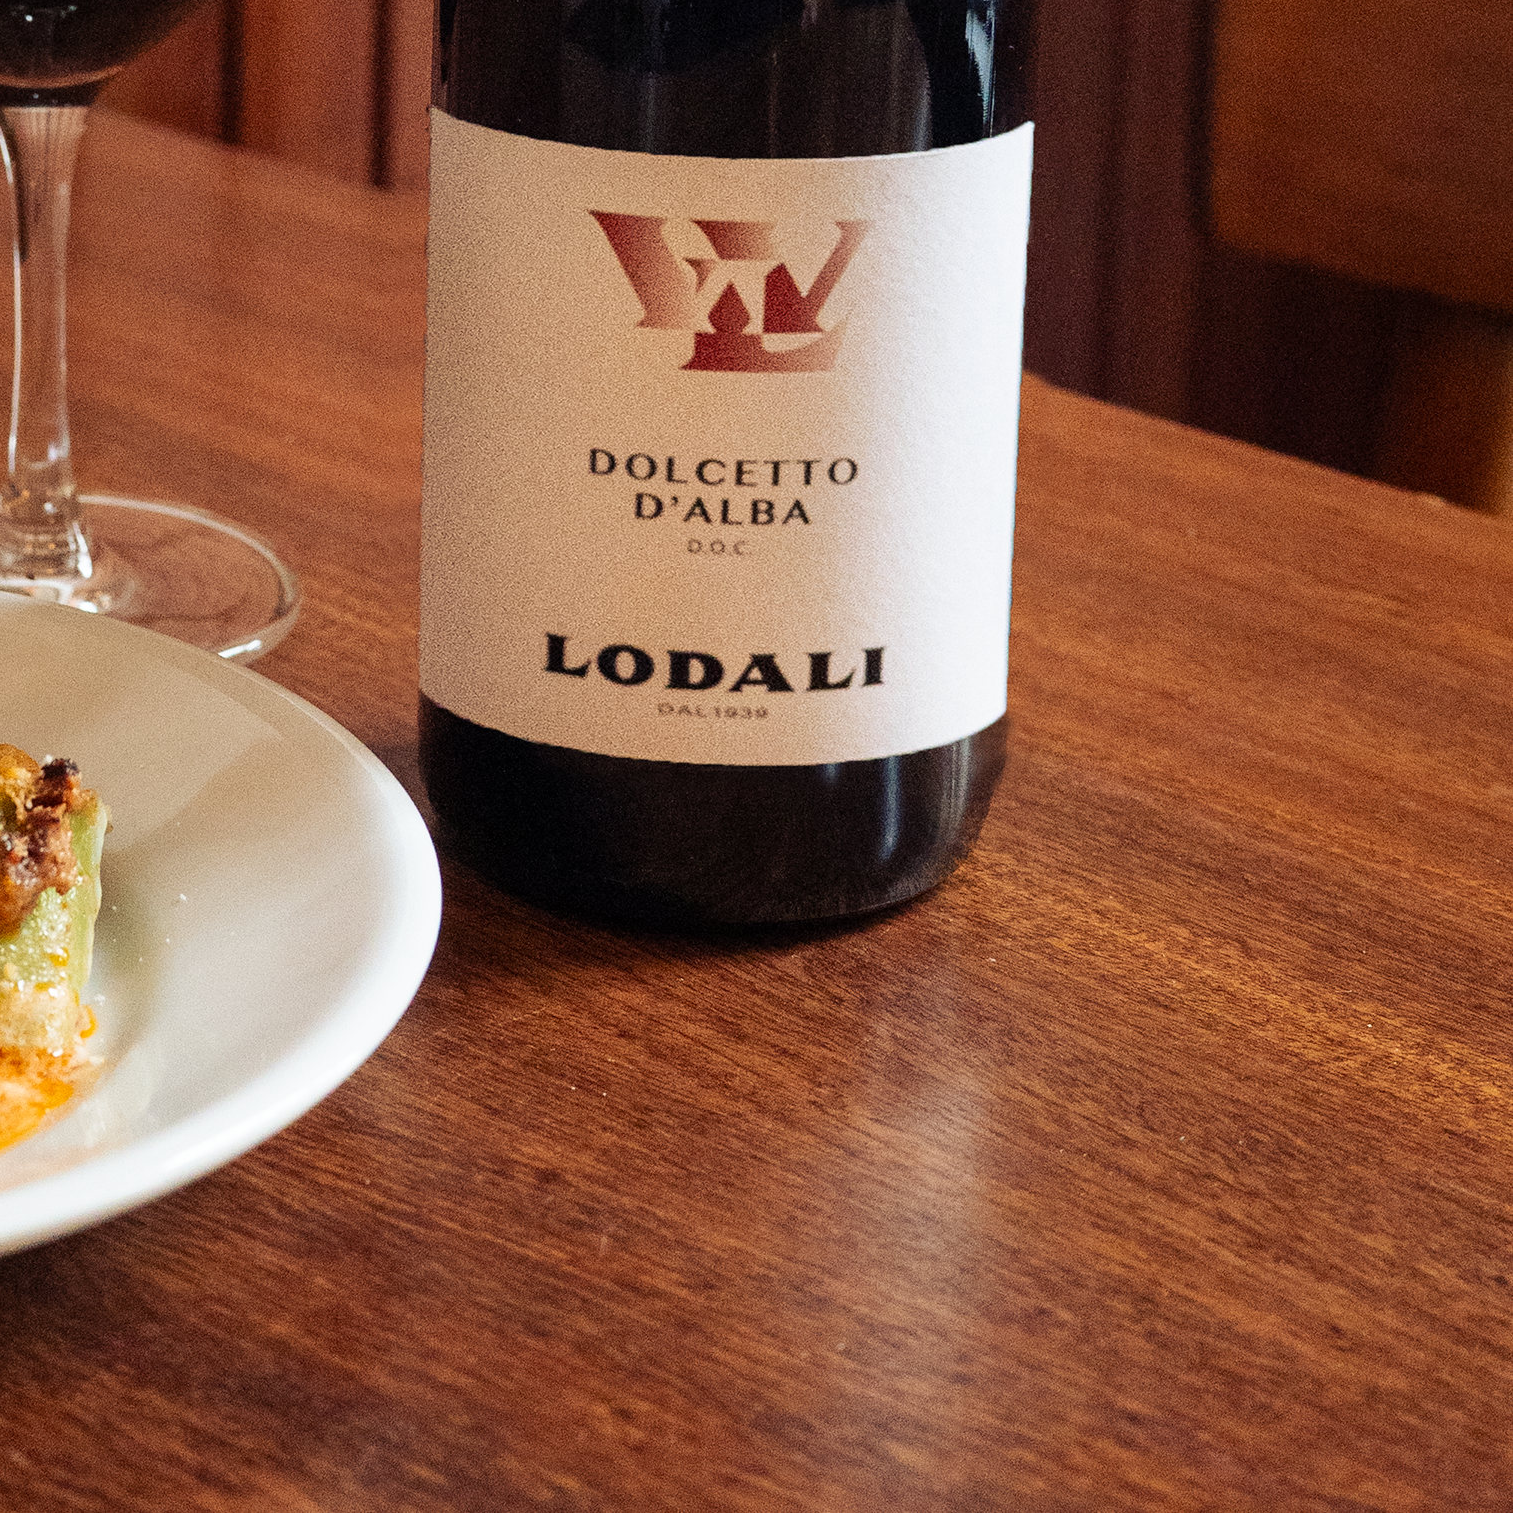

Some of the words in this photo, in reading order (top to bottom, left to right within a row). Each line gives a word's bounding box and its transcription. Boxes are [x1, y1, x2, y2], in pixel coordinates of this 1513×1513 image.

[589, 447, 858, 487] DOLCETTO
[635, 492, 811, 526] D'ALBA
[544, 633, 886, 693] LODALI
